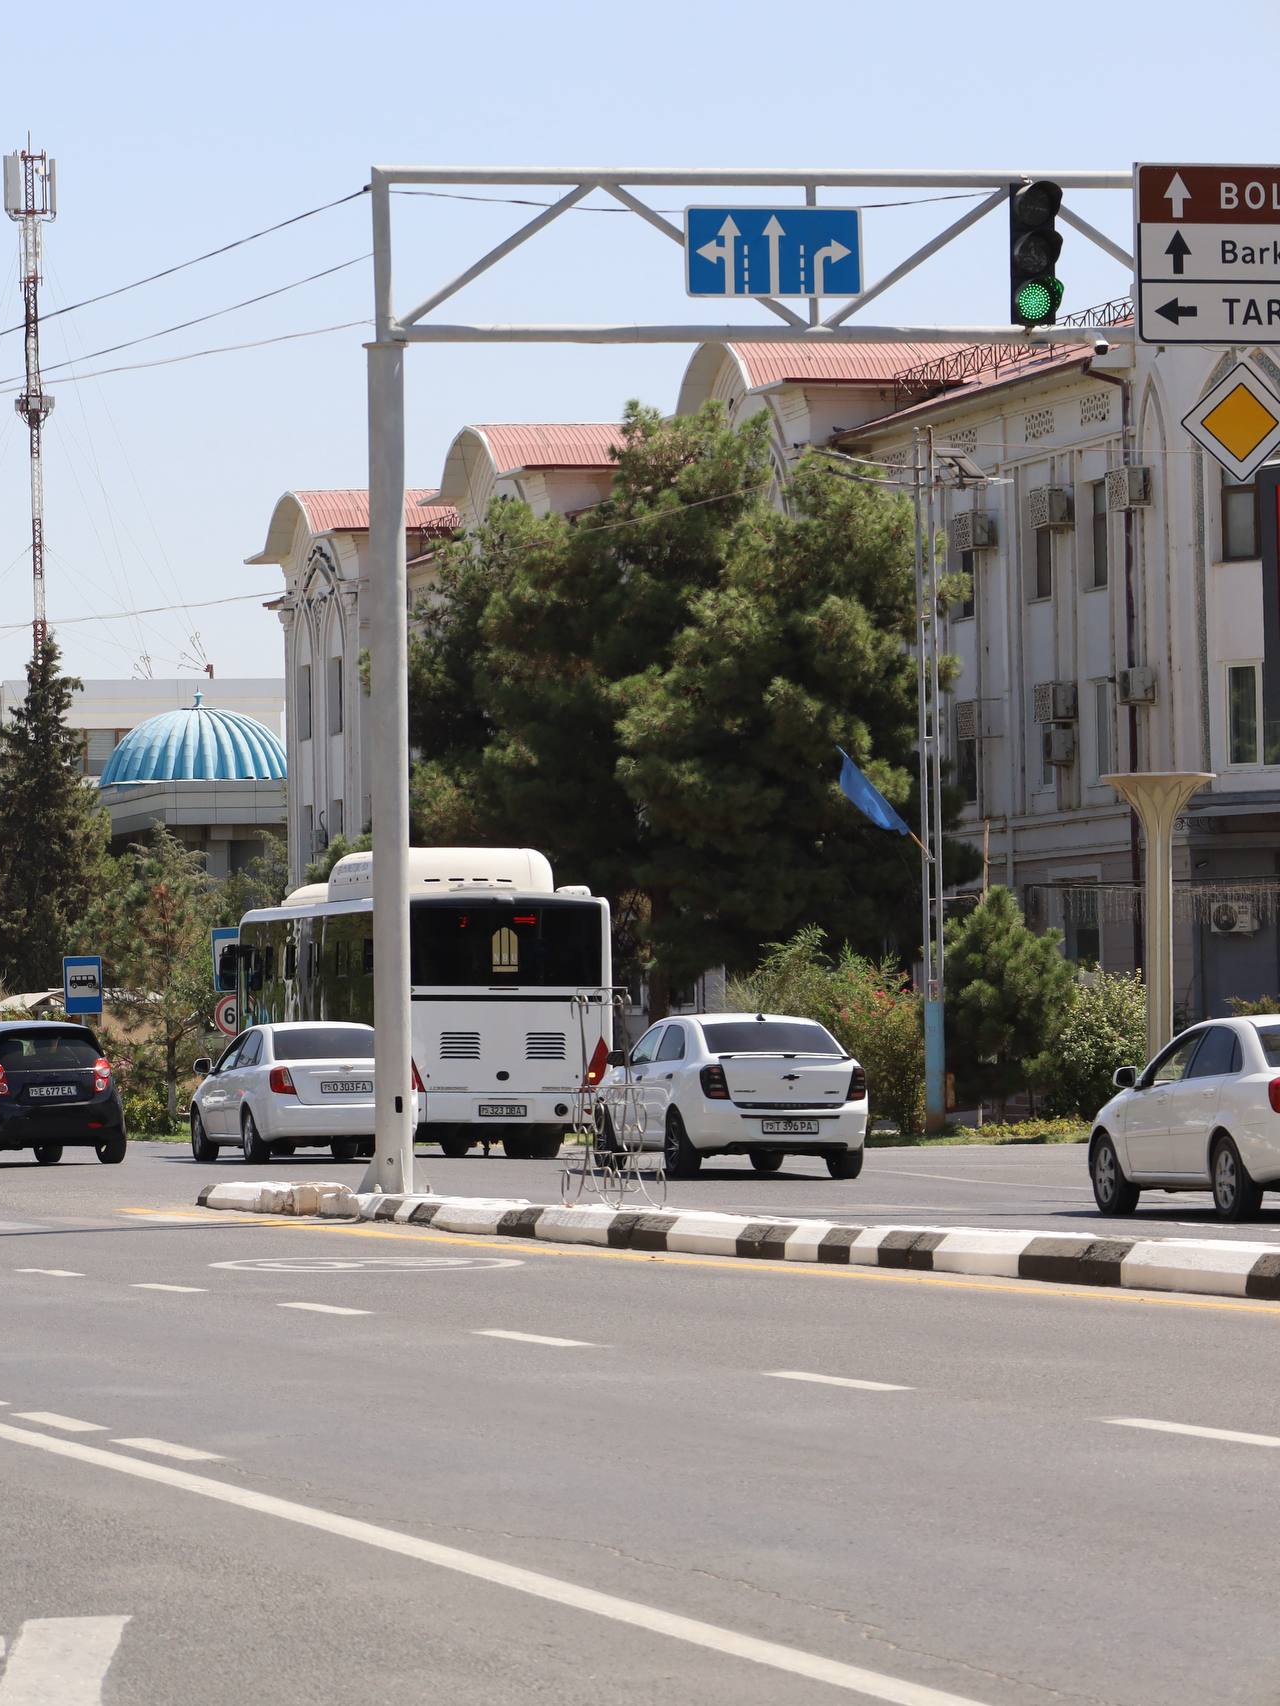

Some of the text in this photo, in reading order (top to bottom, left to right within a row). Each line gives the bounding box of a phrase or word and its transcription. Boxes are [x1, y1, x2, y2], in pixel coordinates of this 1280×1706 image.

[1220, 181, 1280, 210] BOL
[1222, 298, 1280, 326] TAR
[224, 1007, 237, 1025] 6
